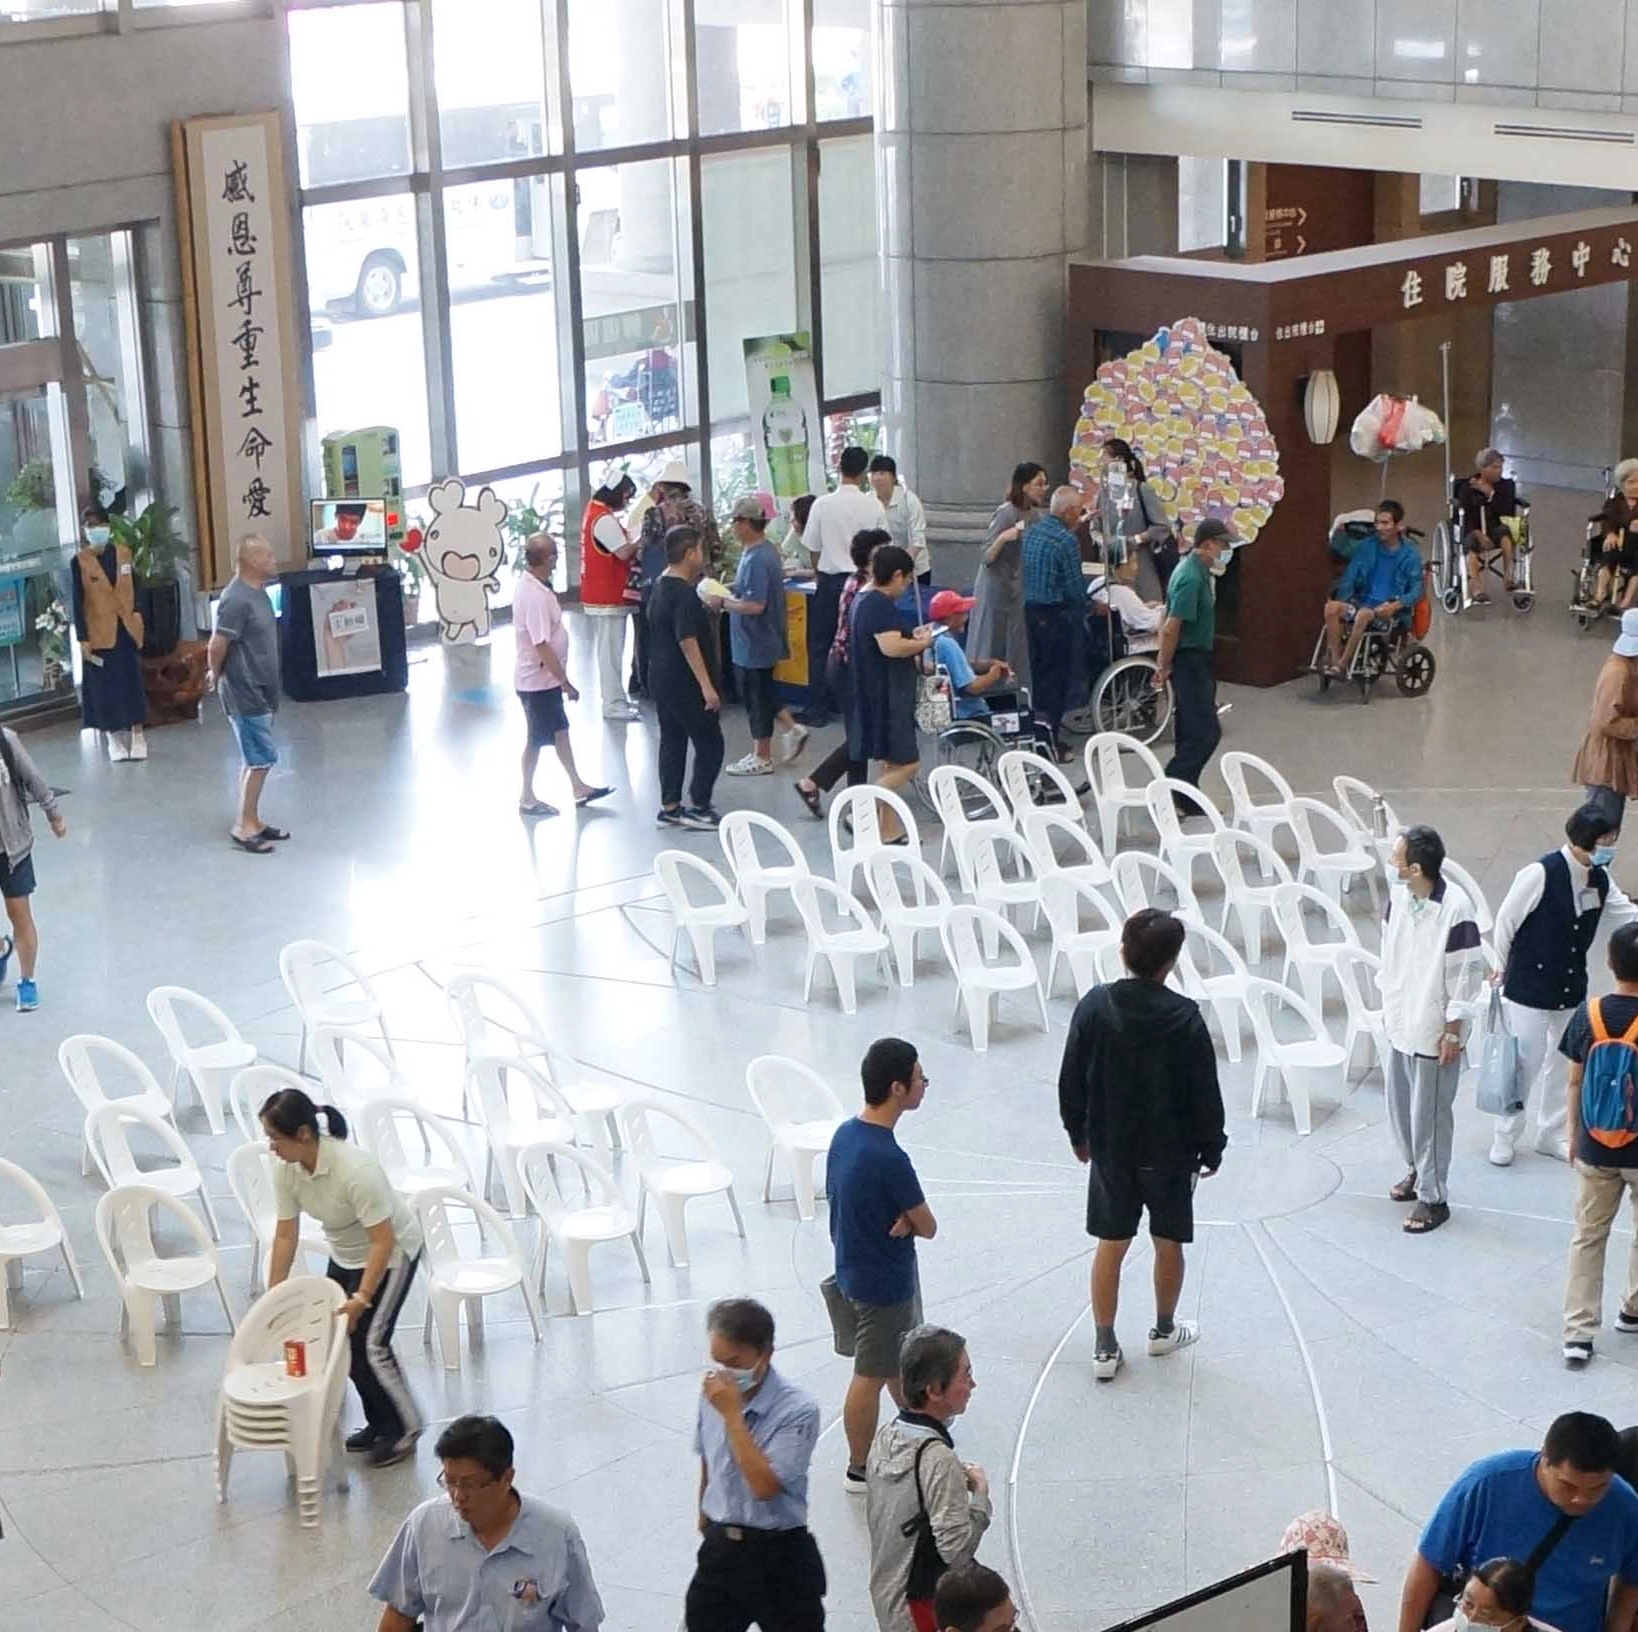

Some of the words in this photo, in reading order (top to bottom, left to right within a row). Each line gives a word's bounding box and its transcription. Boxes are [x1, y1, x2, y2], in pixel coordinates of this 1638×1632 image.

[222, 160, 273, 521] 感恩尊重生命愛
[1401, 237, 1632, 309] 住院服務中心
